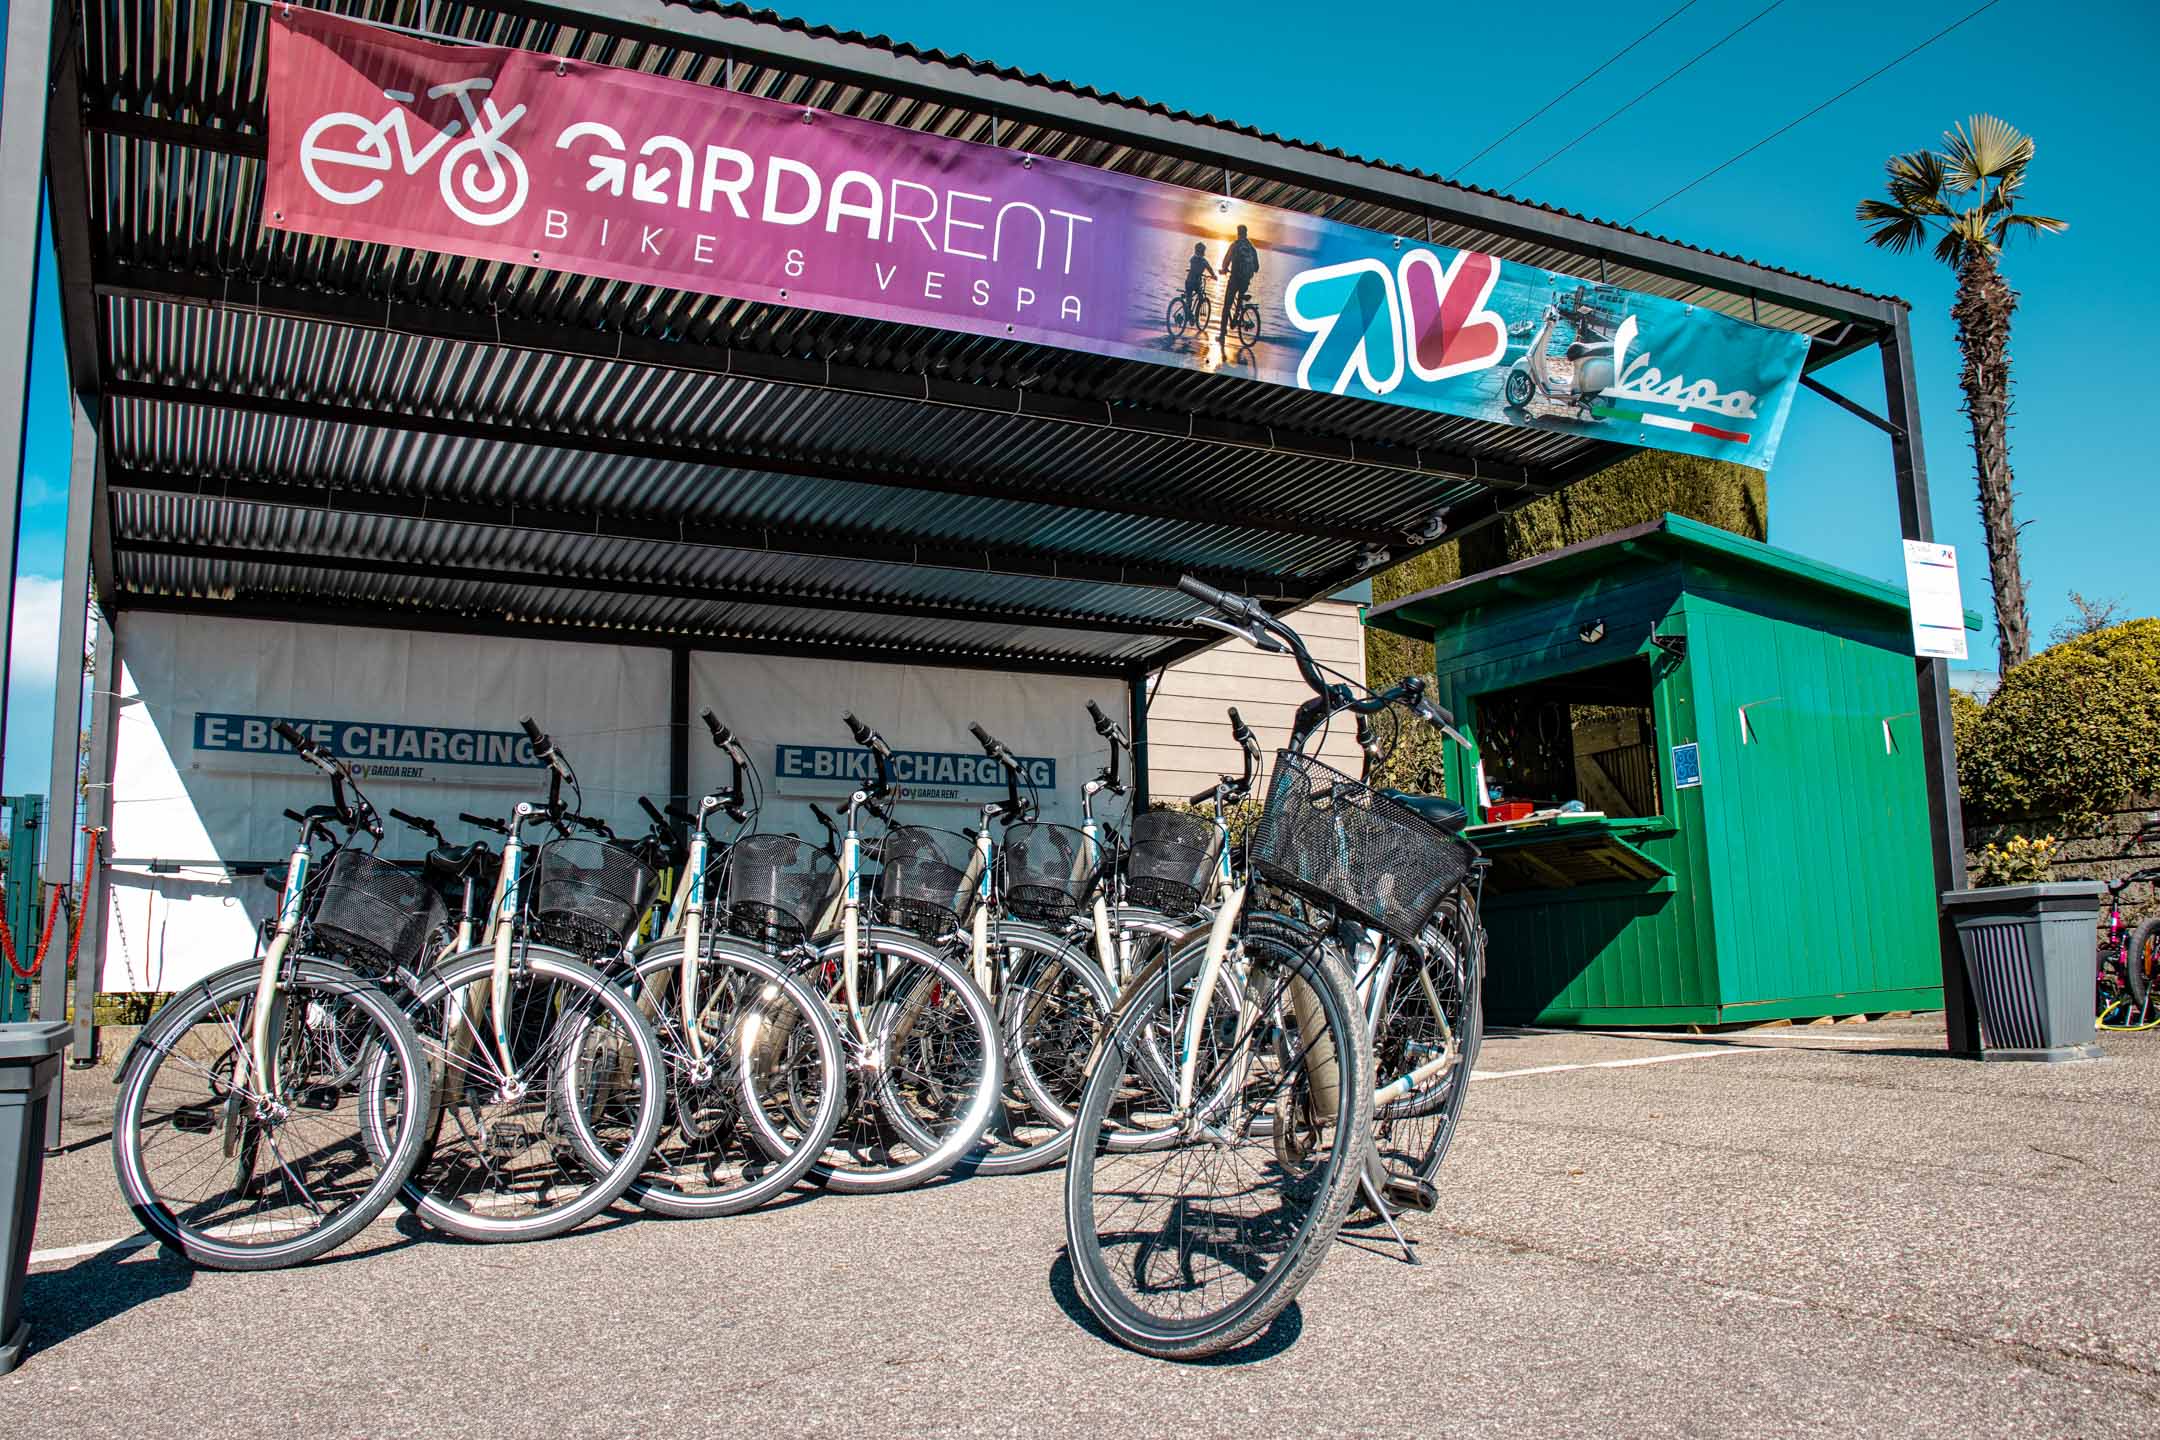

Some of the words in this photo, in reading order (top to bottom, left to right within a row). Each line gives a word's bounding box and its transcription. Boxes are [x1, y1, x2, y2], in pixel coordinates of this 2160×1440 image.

[544, 210, 717, 263] BIKE
[784, 249, 805, 276] &
[875, 262, 1081, 322] VESPA
[1599, 314, 1757, 419] Vespa
[341, 726, 540, 765] CHARGING
[369, 765, 401, 777] GARDA
[401, 767, 424, 778] RENT
[941, 789, 960, 799] RENT
